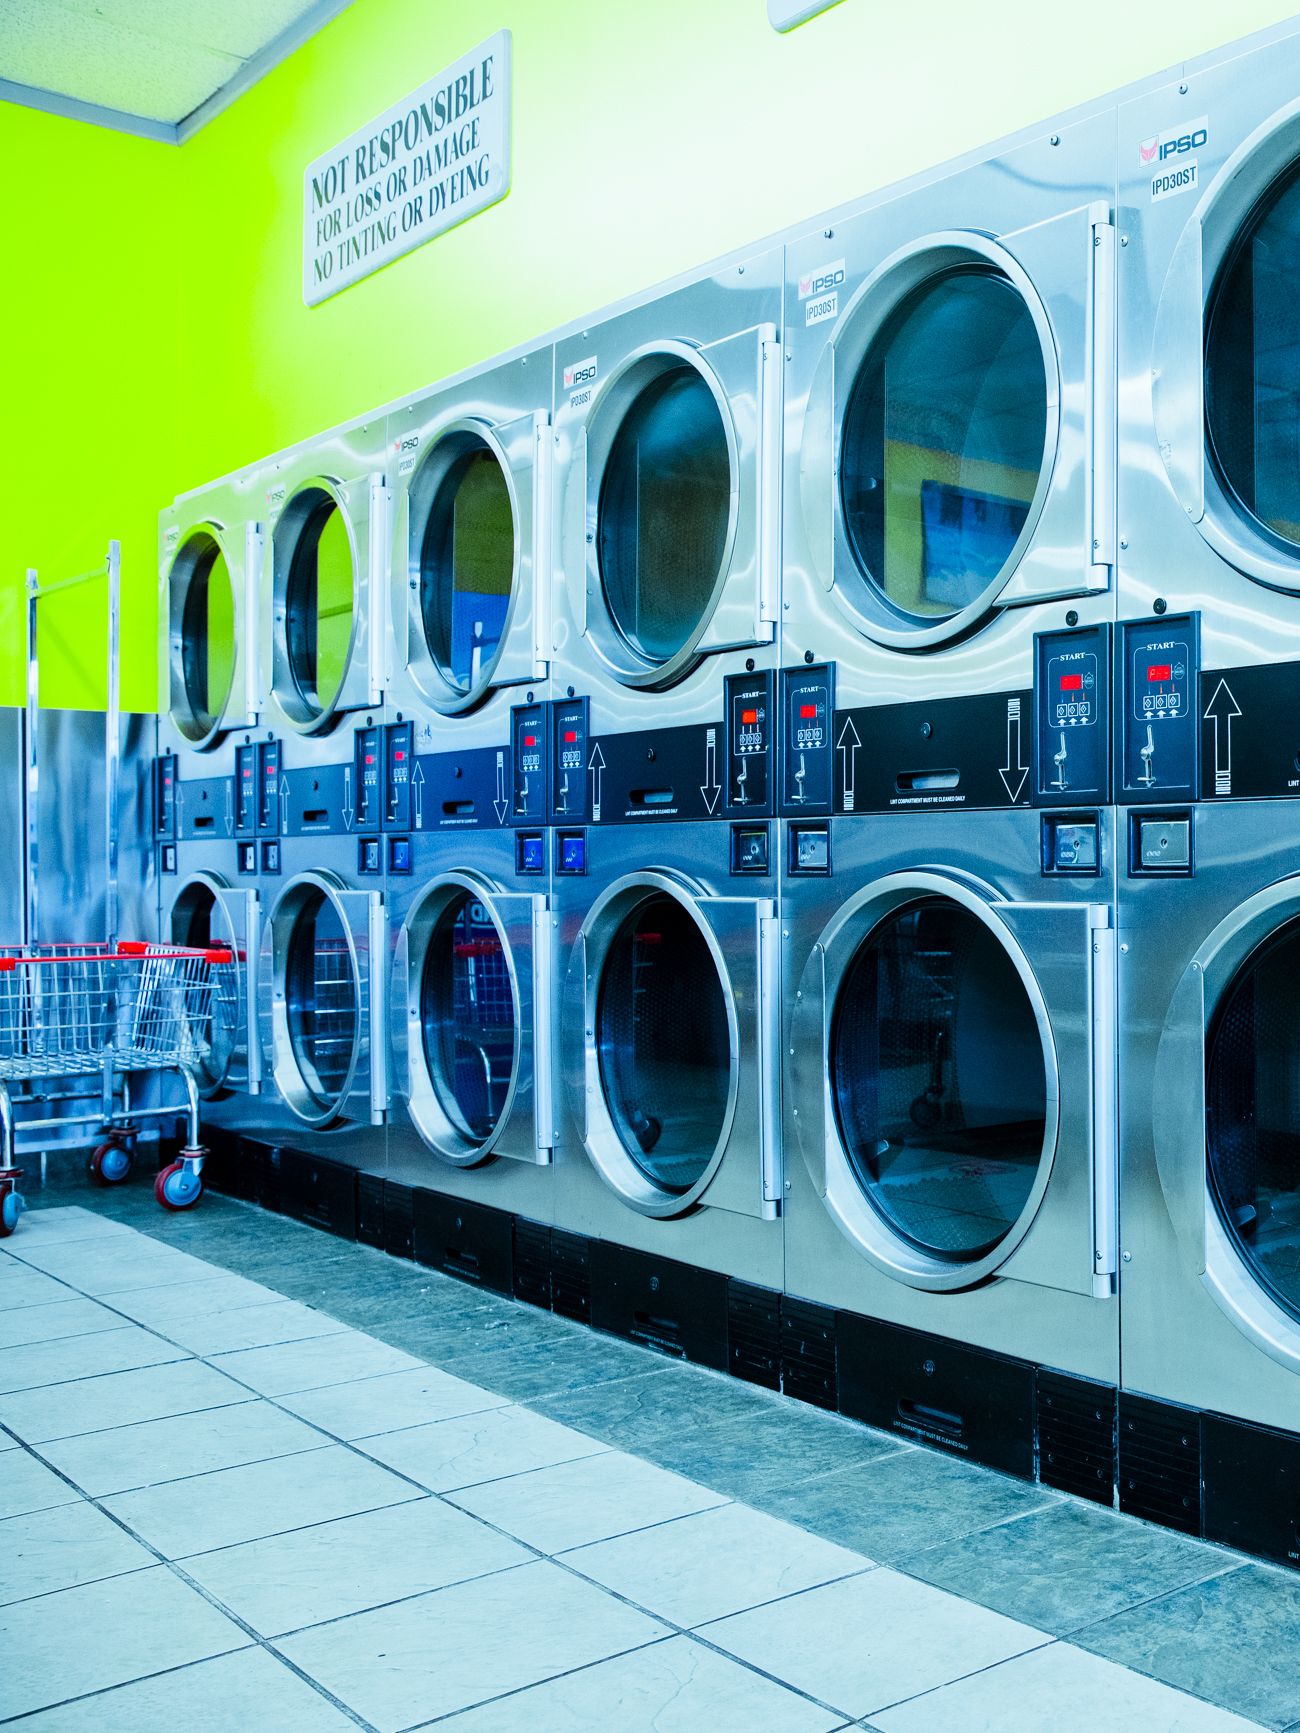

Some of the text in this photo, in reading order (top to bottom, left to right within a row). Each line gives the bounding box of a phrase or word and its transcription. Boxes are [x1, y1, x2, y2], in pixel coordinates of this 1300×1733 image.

[312, 55, 494, 214] NOT RESPONSIBLE
[1159, 129, 1207, 160] IPSO
[316, 117, 480, 248] FOR LOSS OR DAMAGE
[1152, 166, 1197, 196] IPD30ST
[314, 153, 490, 286] NO TINTING OR DYEING
[812, 270, 844, 293] IPSO
[806, 298, 837, 321] IPD30ST
[573, 366, 595, 384] IPSO
[1060, 652, 1086, 661] START
[1147, 641, 1174, 651] START
[799, 686, 819, 694] START
[1288, 1551, 1300, 1560] LINT
